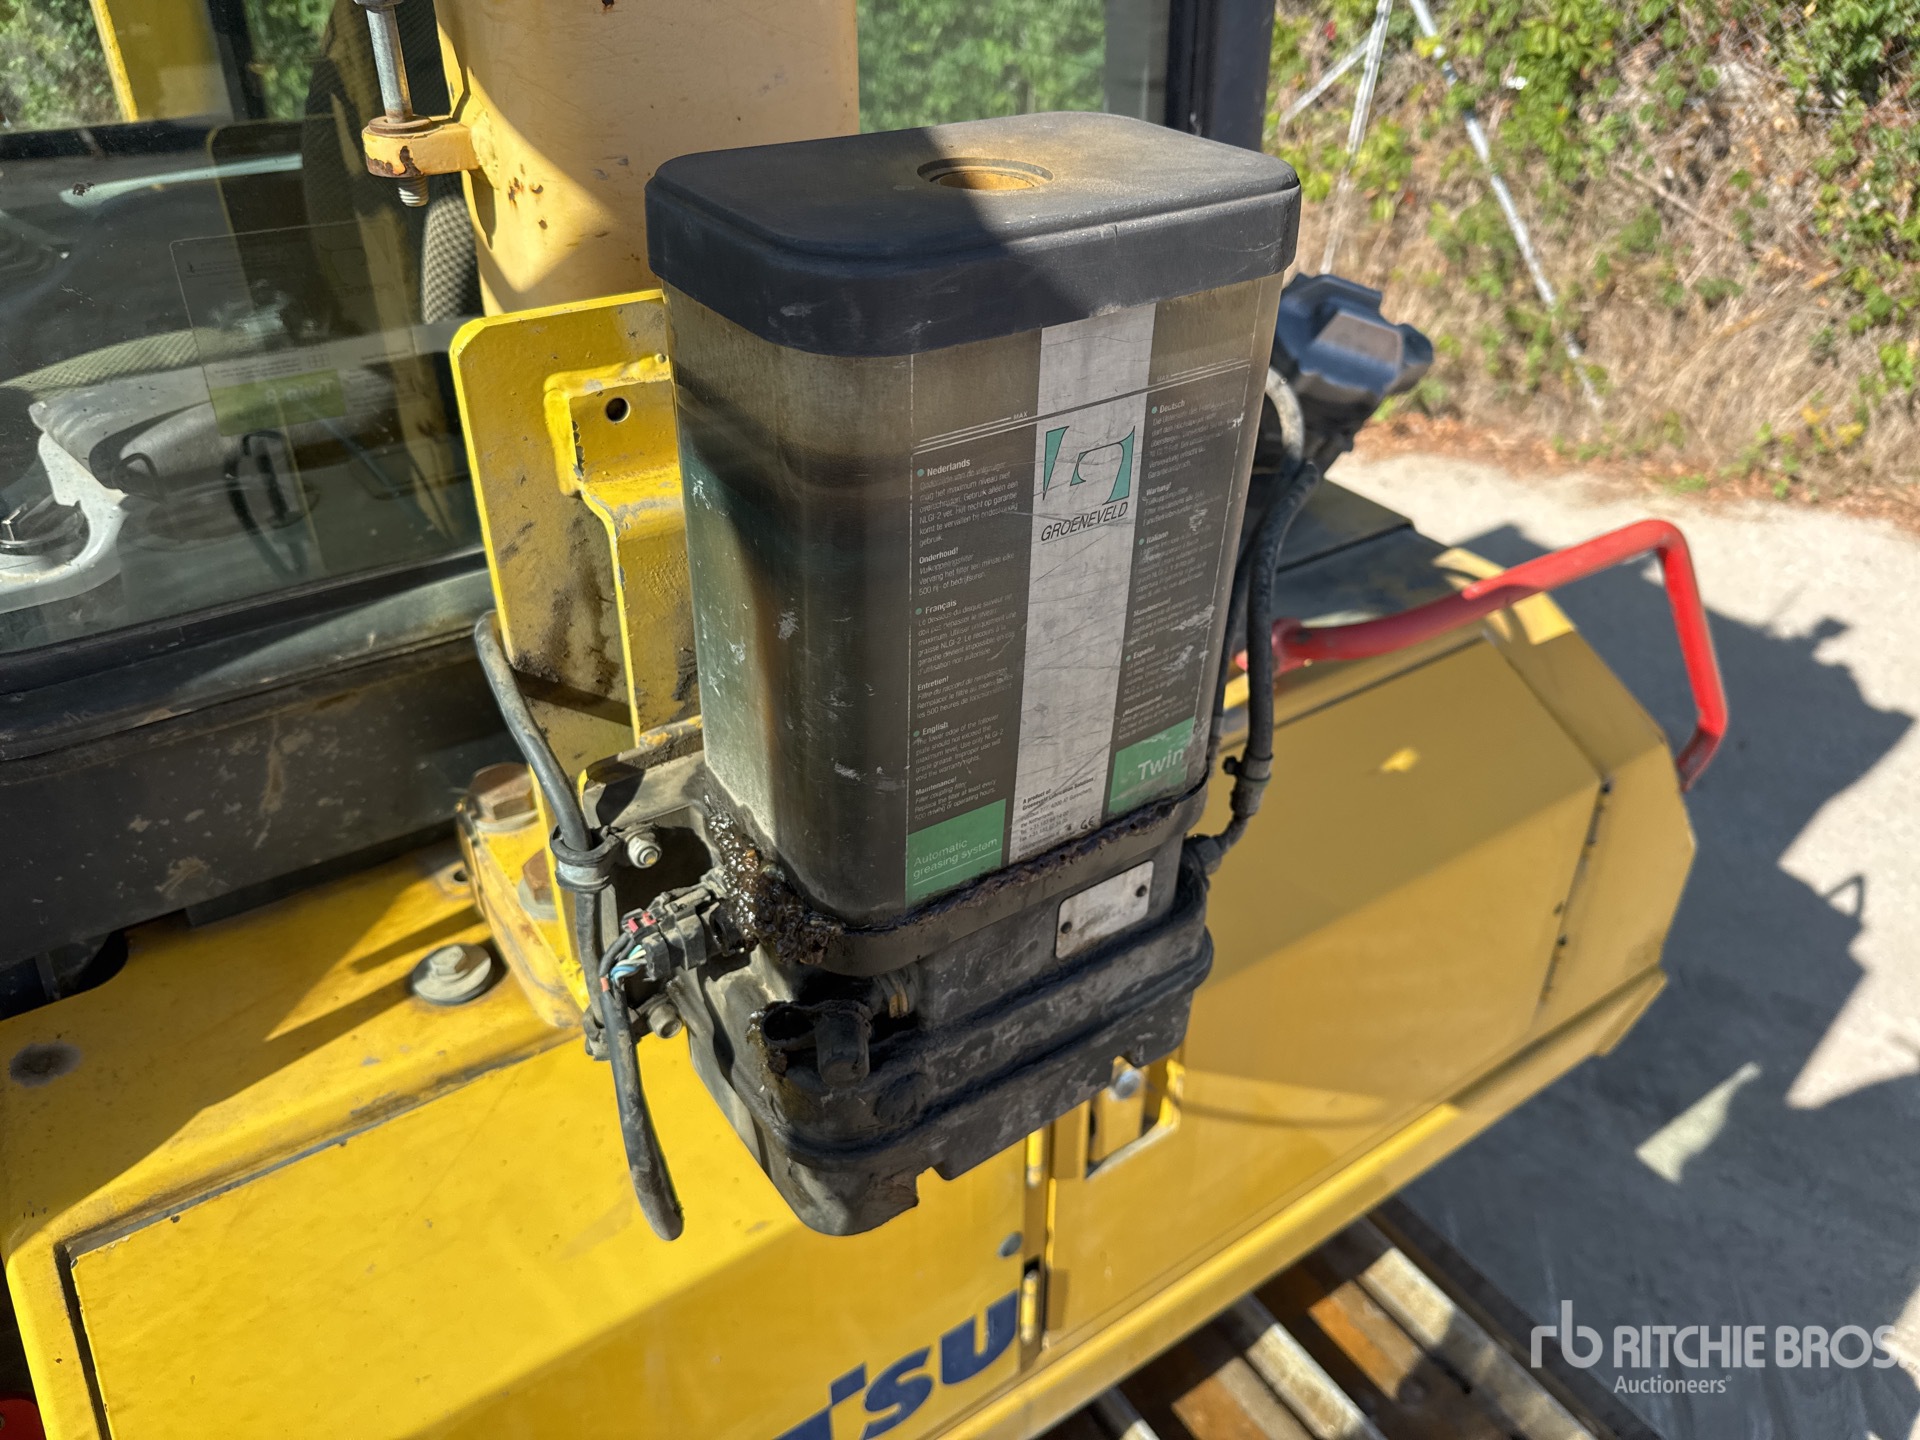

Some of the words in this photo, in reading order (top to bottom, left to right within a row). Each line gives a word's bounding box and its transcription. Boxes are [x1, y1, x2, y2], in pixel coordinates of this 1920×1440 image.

[1013, 411, 1028, 420] MAX
[927, 459, 970, 475] Nederlands
[1041, 502, 1128, 541] GROENEVELD
[919, 547, 958, 563] Onderhoud!
[925, 600, 956, 613] Français
[922, 721, 948, 735] English
[1138, 748, 1184, 781] Twin
[912, 853, 959, 880] greasing
[961, 837, 998, 860] system
[914, 839, 968, 867] Automatic
